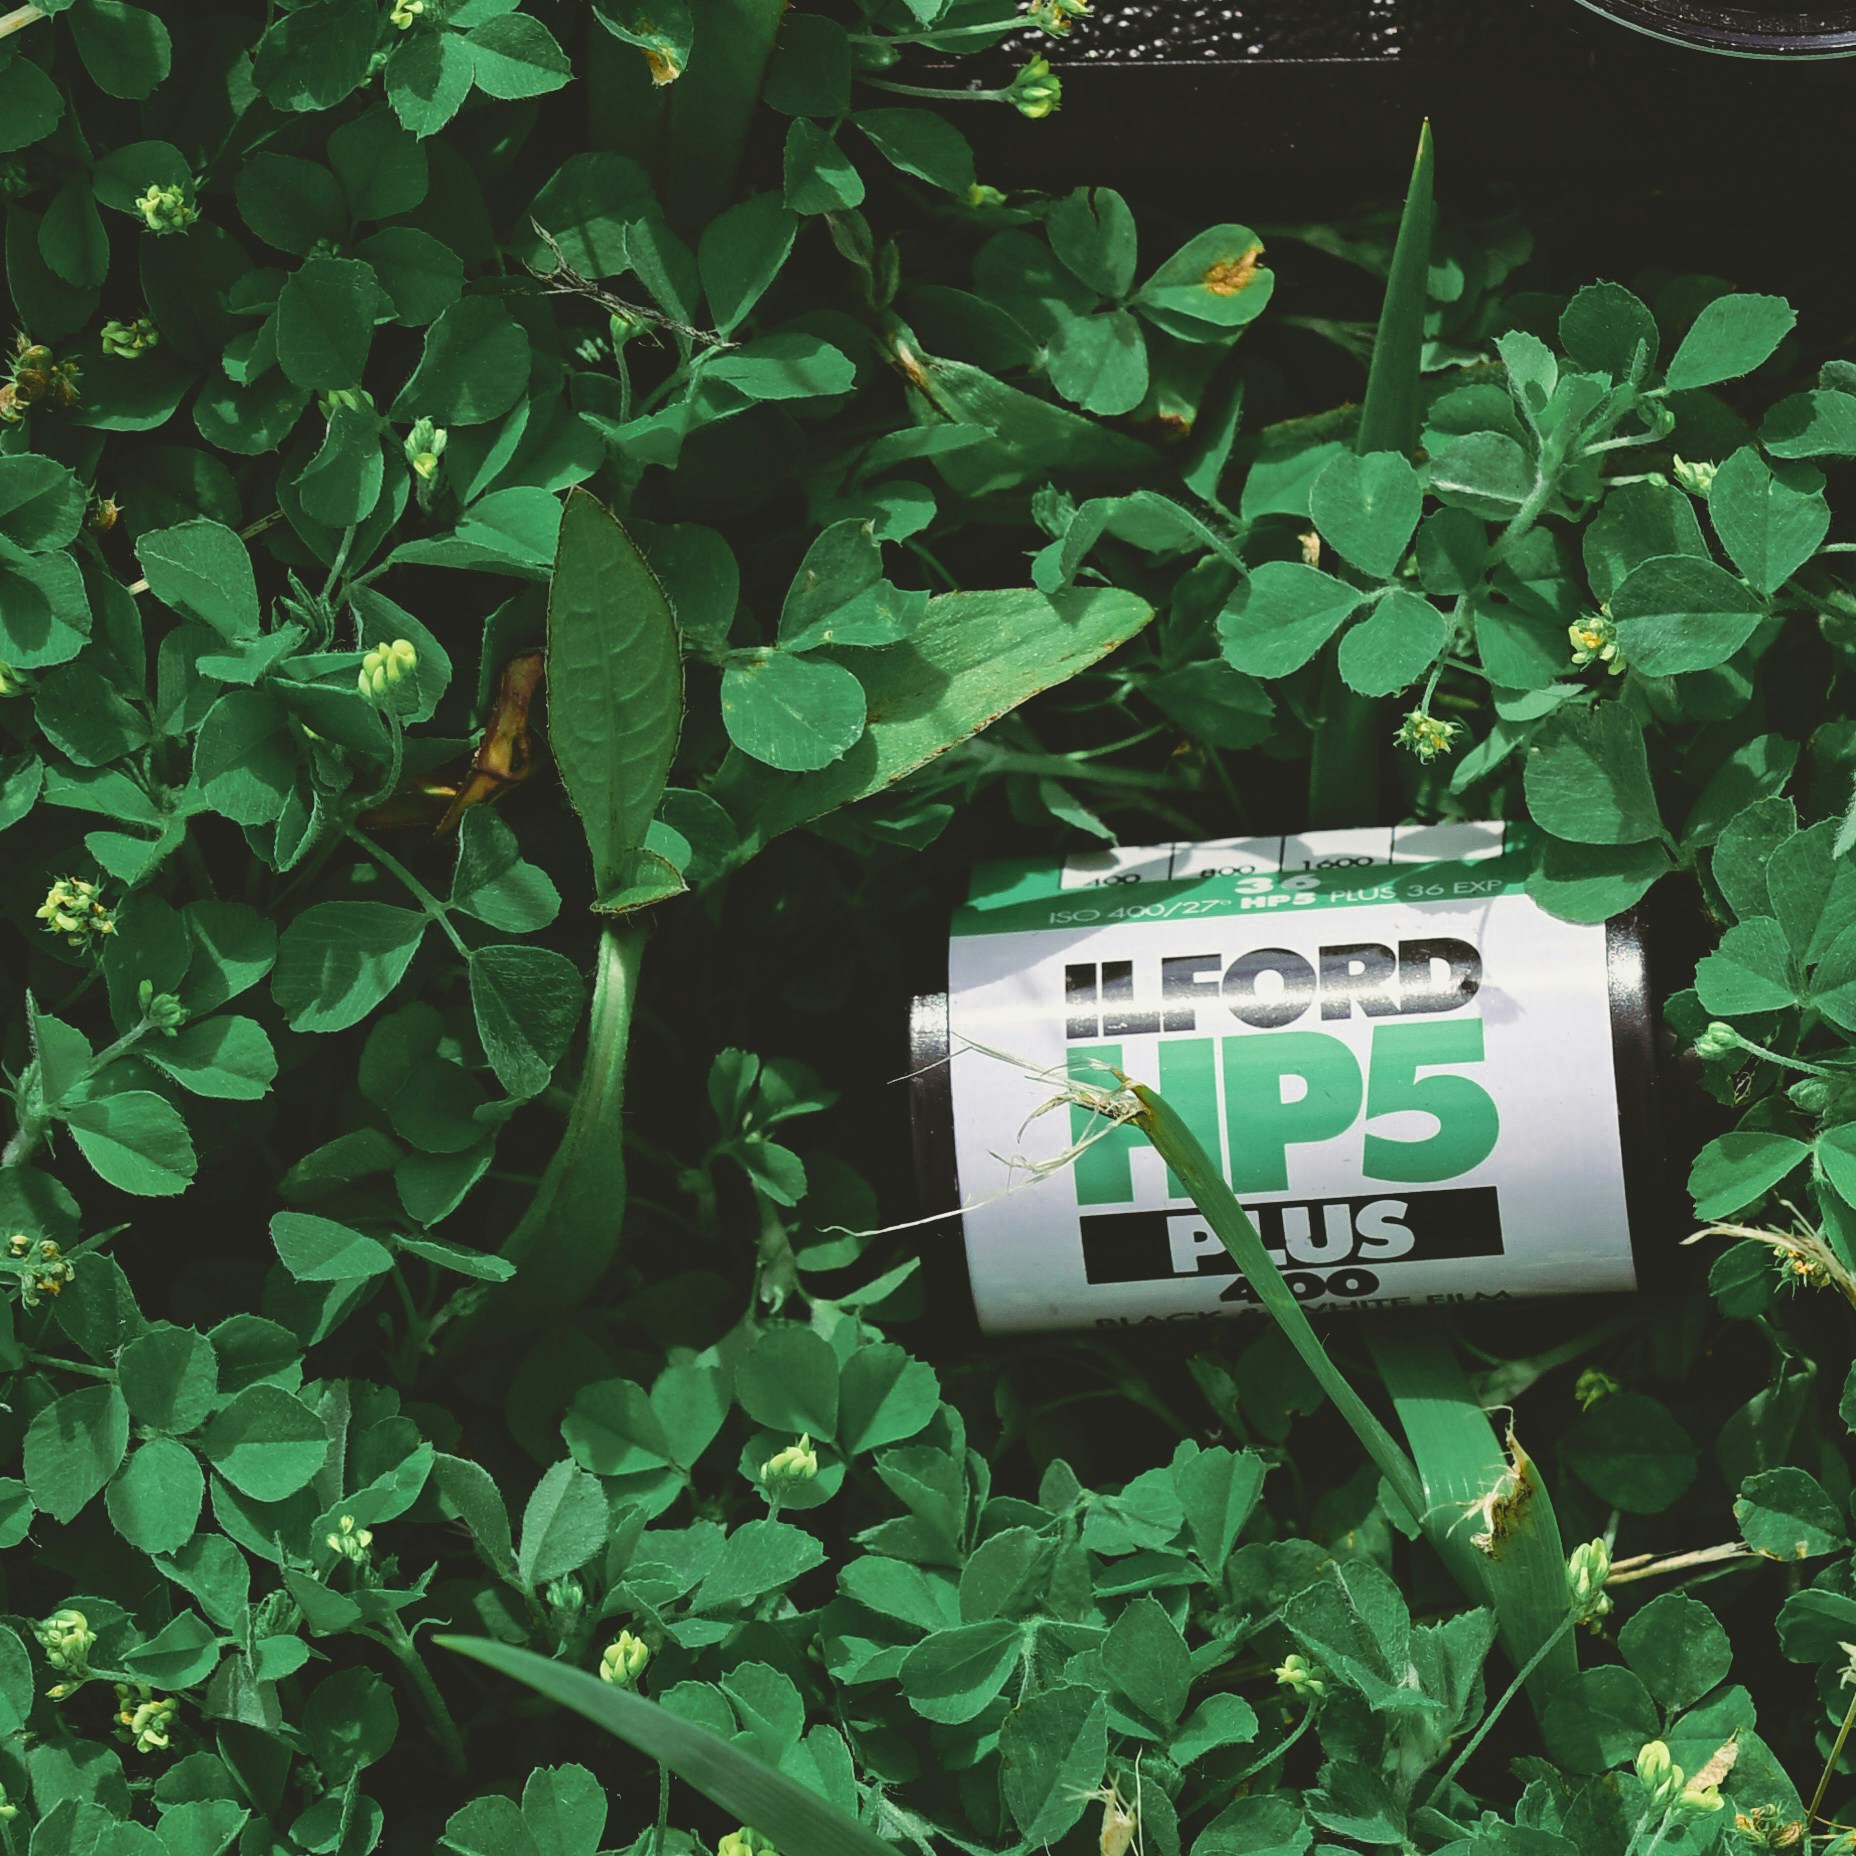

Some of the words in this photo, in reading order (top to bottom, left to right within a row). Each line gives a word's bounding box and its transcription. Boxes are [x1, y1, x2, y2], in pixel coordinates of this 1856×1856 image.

[1200, 865, 1255, 878] 800
[1303, 856, 1374, 871] 1600
[1234, 874, 1321, 894] 36
[1049, 909, 1101, 924] ISO
[1240, 892, 1316, 909] HP5
[1330, 886, 1396, 903] PLUS
[1408, 884, 1445, 898] 36
[1453, 879, 1503, 894] EXP
[1065, 937, 1482, 1039] ILFORD
[1066, 1018, 1500, 1205] HP5
[1219, 1268, 1380, 1303] 400
